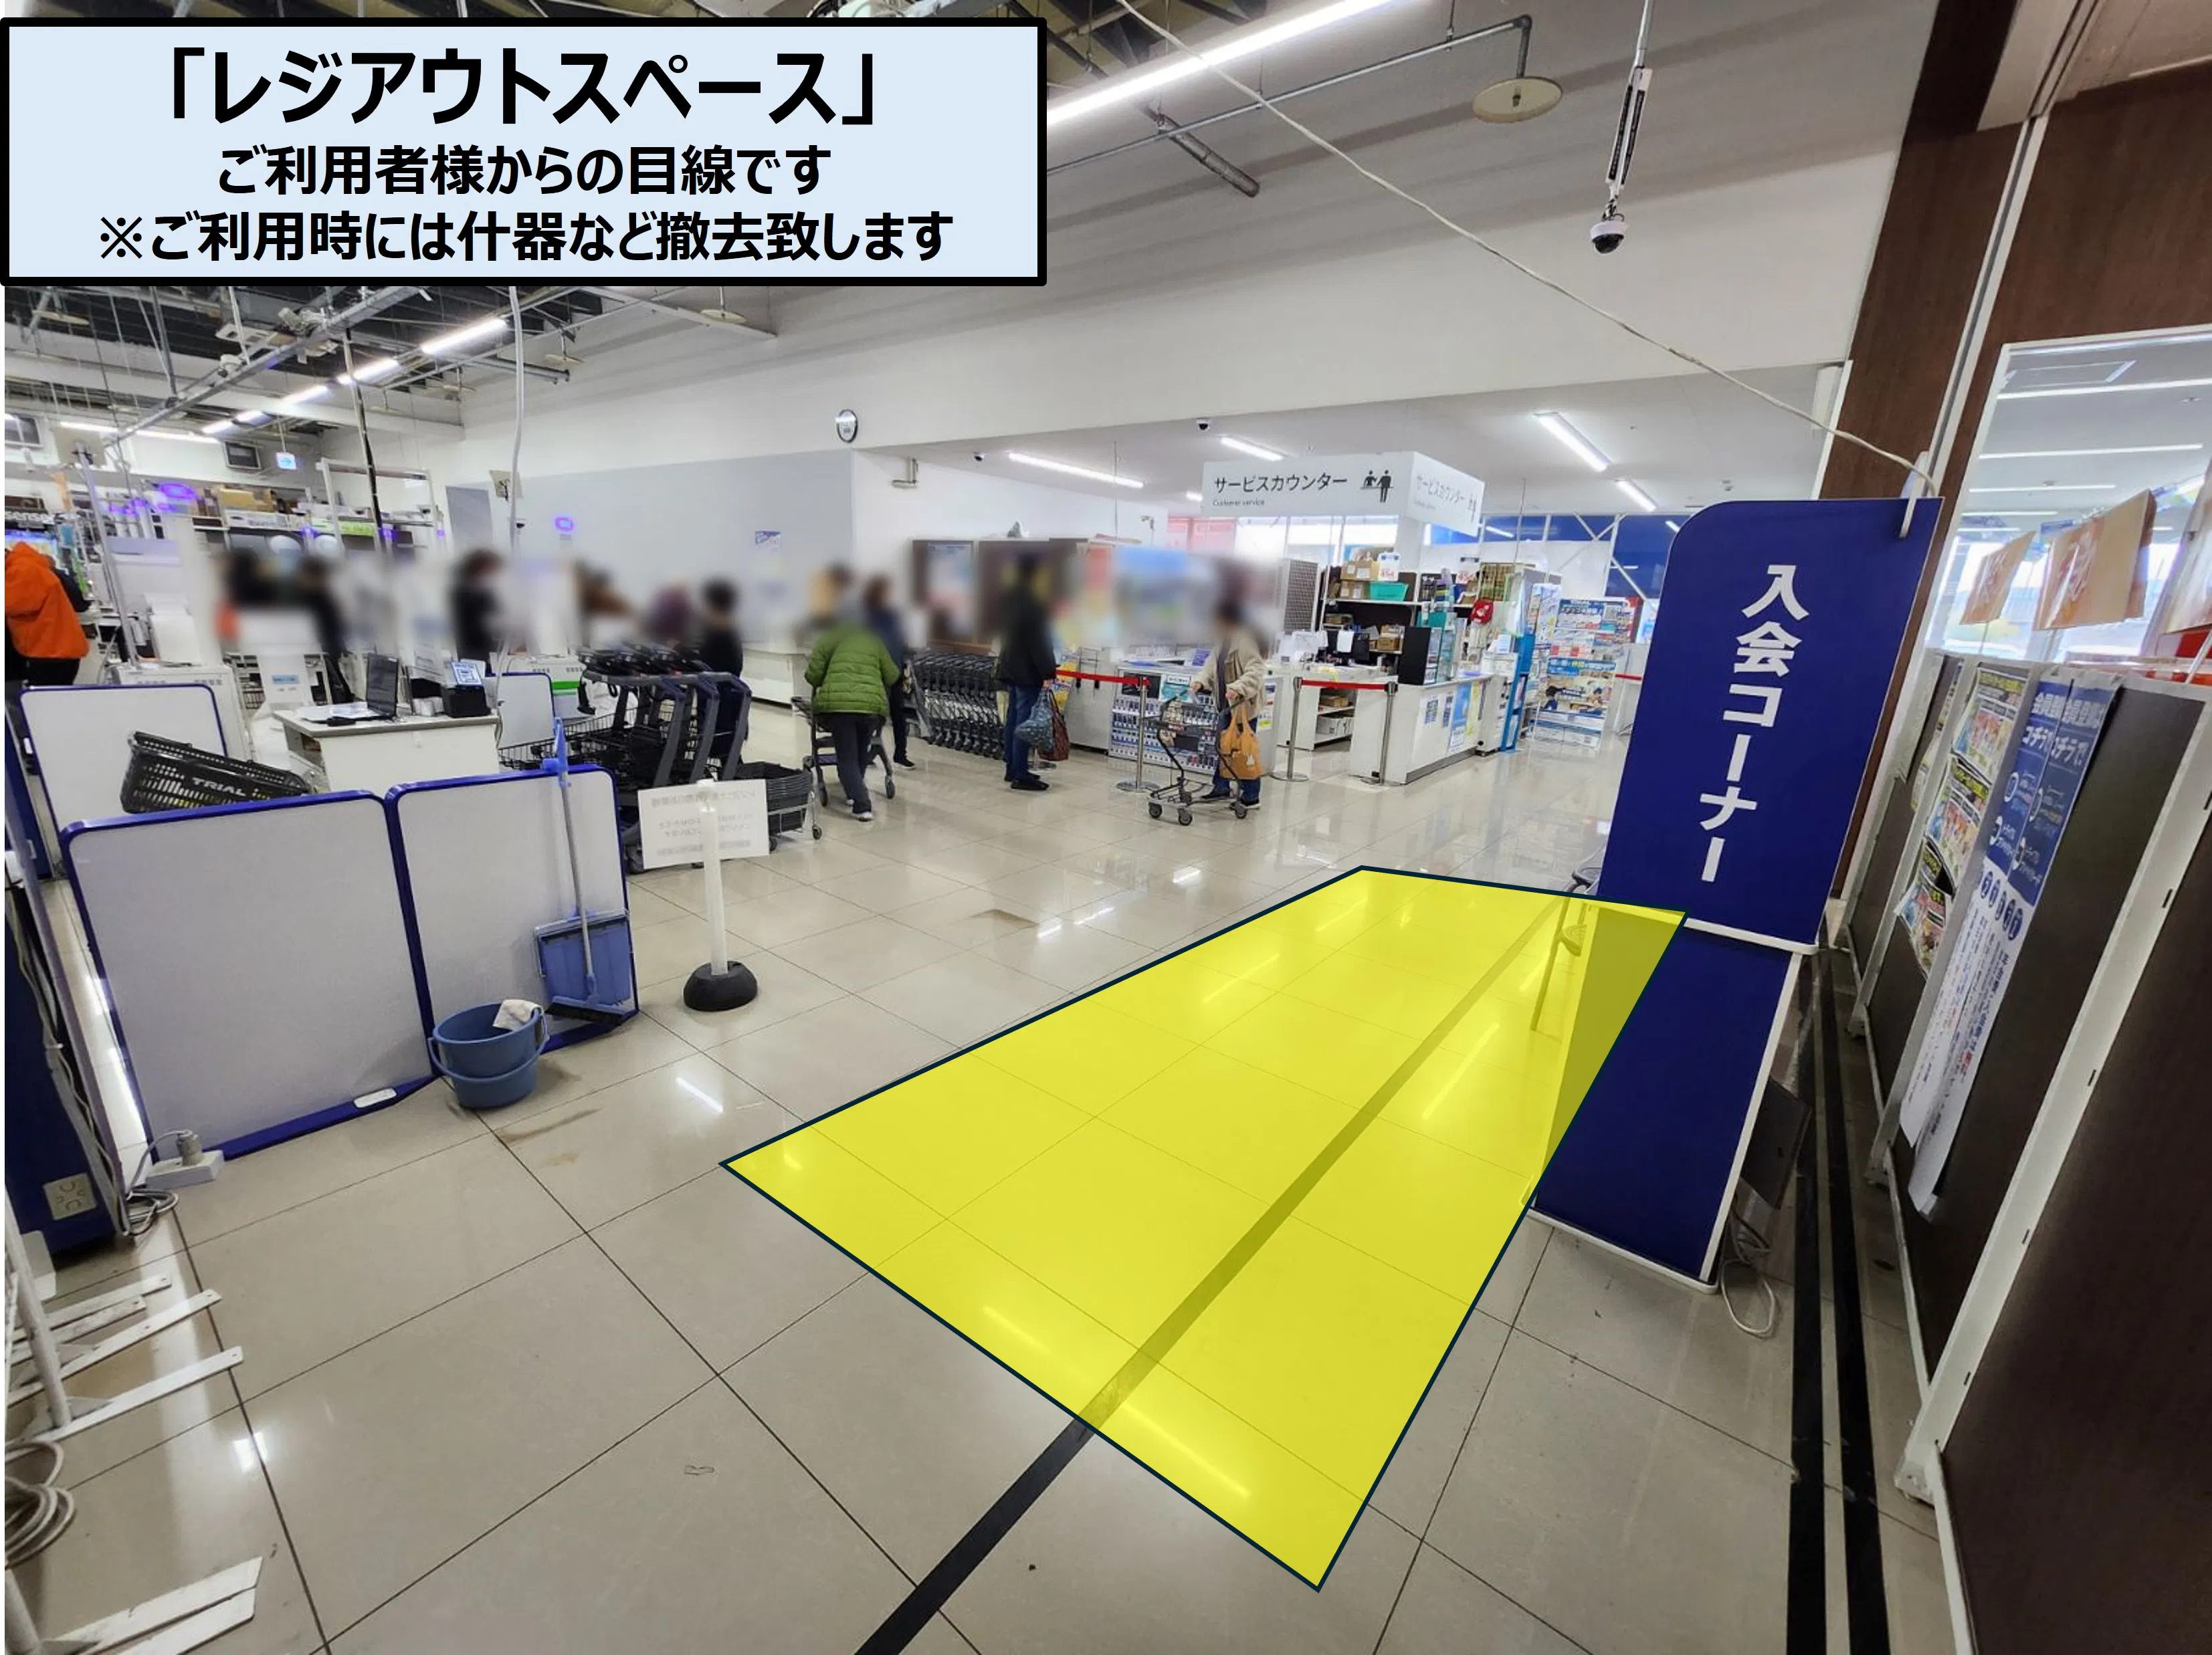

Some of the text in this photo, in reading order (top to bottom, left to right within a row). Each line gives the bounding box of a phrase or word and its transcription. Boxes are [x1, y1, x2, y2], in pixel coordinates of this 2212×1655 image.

[1214, 471, 1348, 494] サービスカウンター
[1699, 564, 1810, 883] 入会コーナー
[191, 776, 247, 796] TRIAL
